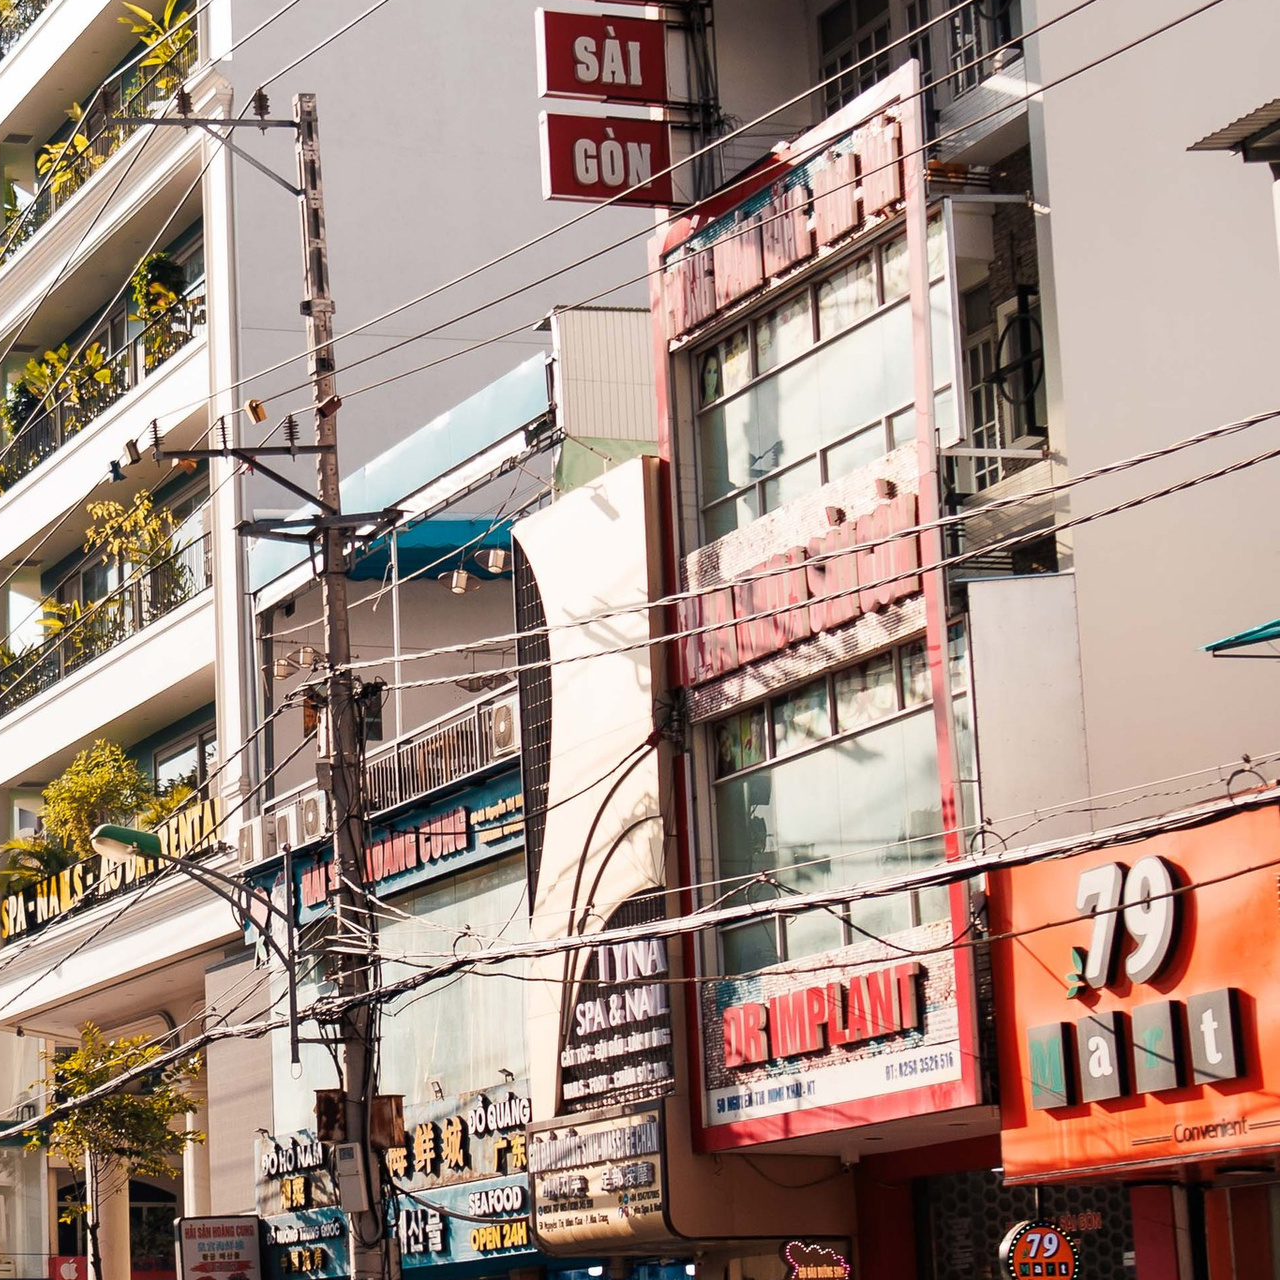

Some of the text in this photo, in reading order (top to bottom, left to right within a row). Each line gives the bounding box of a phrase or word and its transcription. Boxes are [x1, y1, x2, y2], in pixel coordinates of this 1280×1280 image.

[574, 26, 642, 86] SÀI
[573, 127, 652, 189] GÒN
[420, 806, 469, 863] CUNG
[1, 891, 27, 938] SPA
[1076, 855, 1174, 988] 79
[593, 939, 668, 987] TYNA
[576, 983, 669, 1036] SPA & NAIL
[723, 1002, 768, 1068] DR
[770, 962, 920, 1059] IMPLANT
[1030, 1008, 1222, 1097] Mart
[296, 1141, 323, 1168] NAM
[1174, 1118, 1248, 1144] Convenient
[469, 1185, 522, 1216] SEAFOOD
[471, 1220, 527, 1252] OPEN 24H
[1026, 1232, 1059, 1258] 79
[1020, 1263, 1068, 1275] Mart
